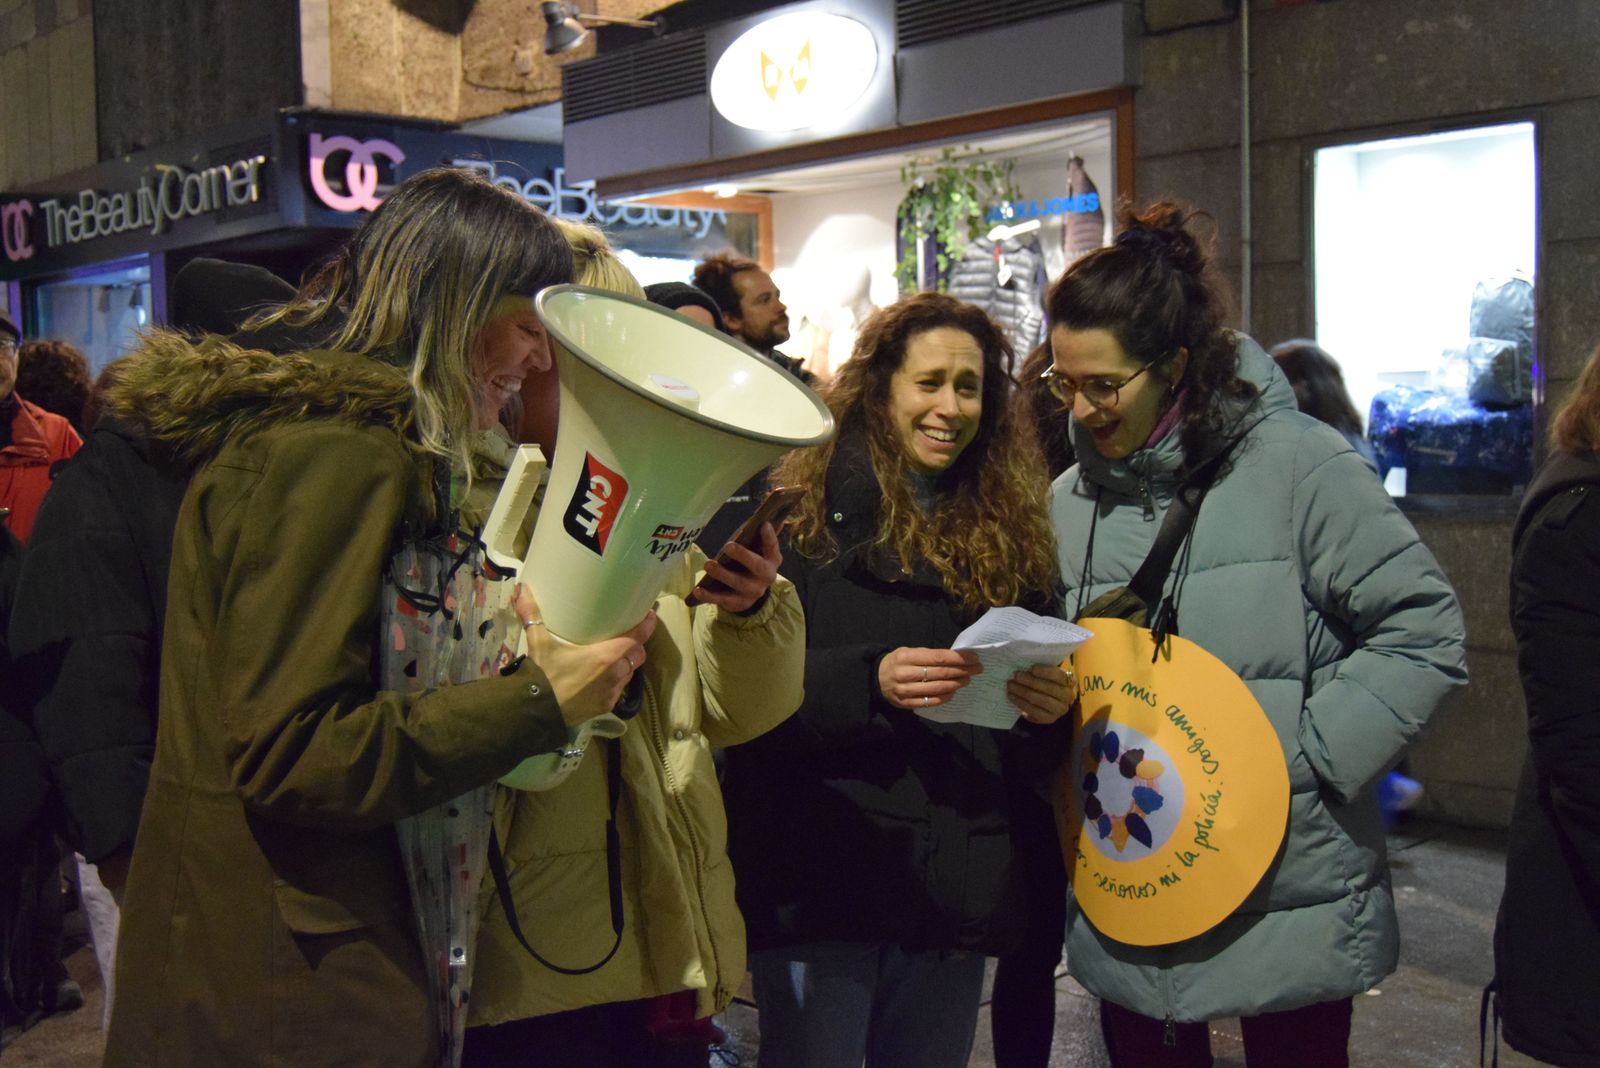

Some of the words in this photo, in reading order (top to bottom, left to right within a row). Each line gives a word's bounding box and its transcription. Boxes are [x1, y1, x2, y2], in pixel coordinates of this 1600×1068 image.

[40, 155, 266, 247] TheBeautyCorner
[575, 475, 612, 538] CNT
[1081, 674, 1115, 697] an
[1121, 680, 1157, 708] mis
[1175, 850, 1200, 868] la
